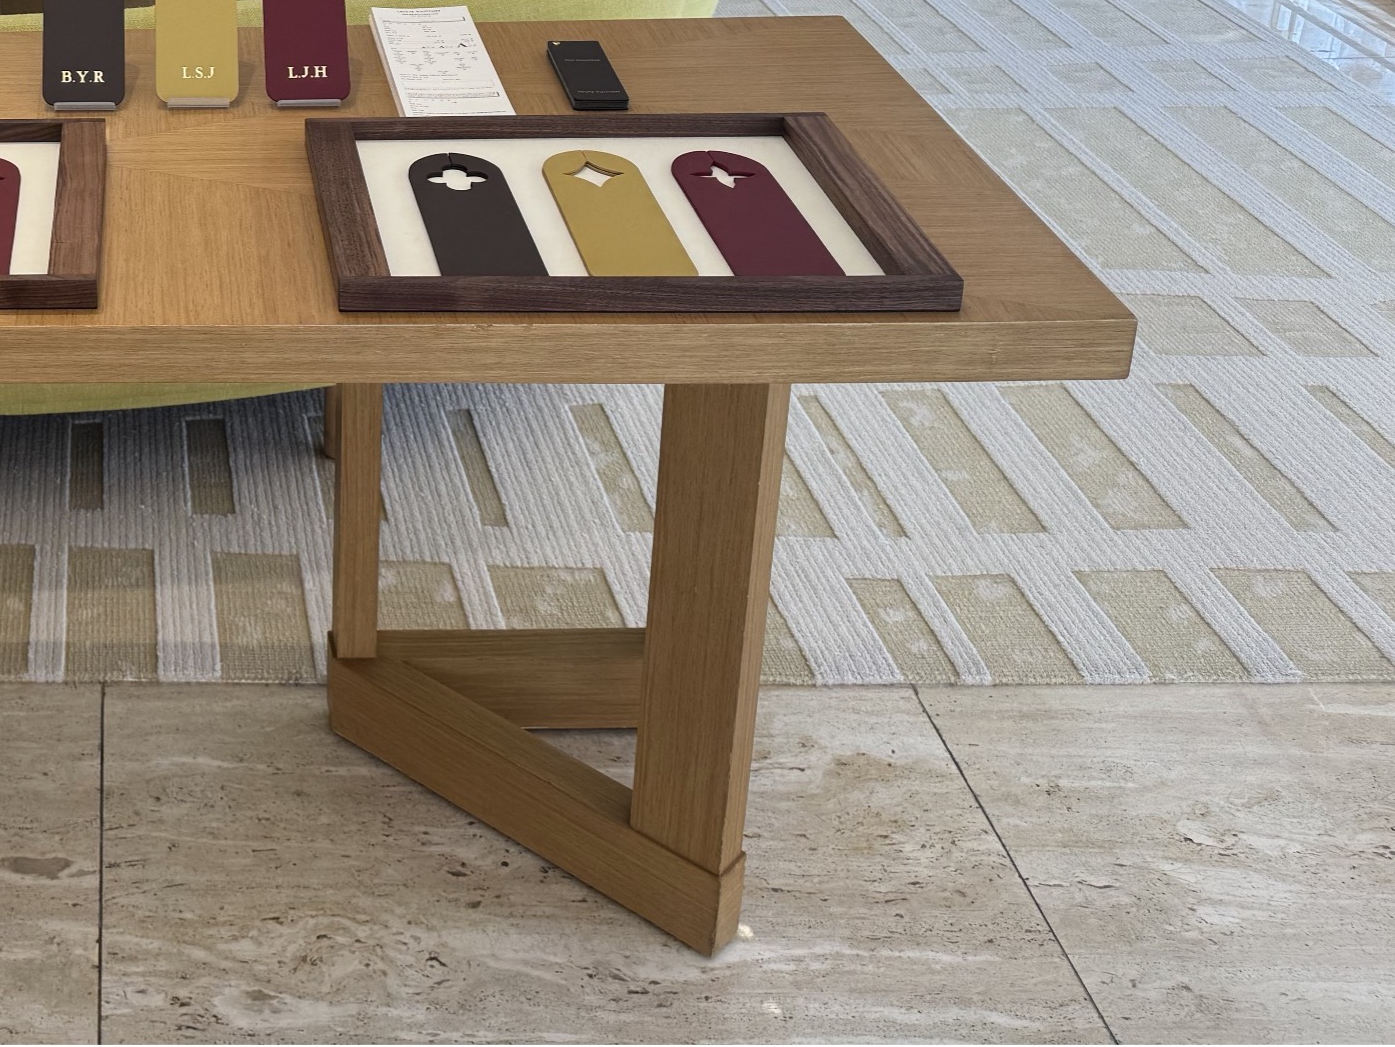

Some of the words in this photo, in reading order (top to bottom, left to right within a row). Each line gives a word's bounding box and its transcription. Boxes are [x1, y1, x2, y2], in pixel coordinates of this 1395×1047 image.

[60, 70, 106, 84] B.Y.R
[181, 66, 215, 80] L.S.J
[287, 65, 328, 79] L.J.H
